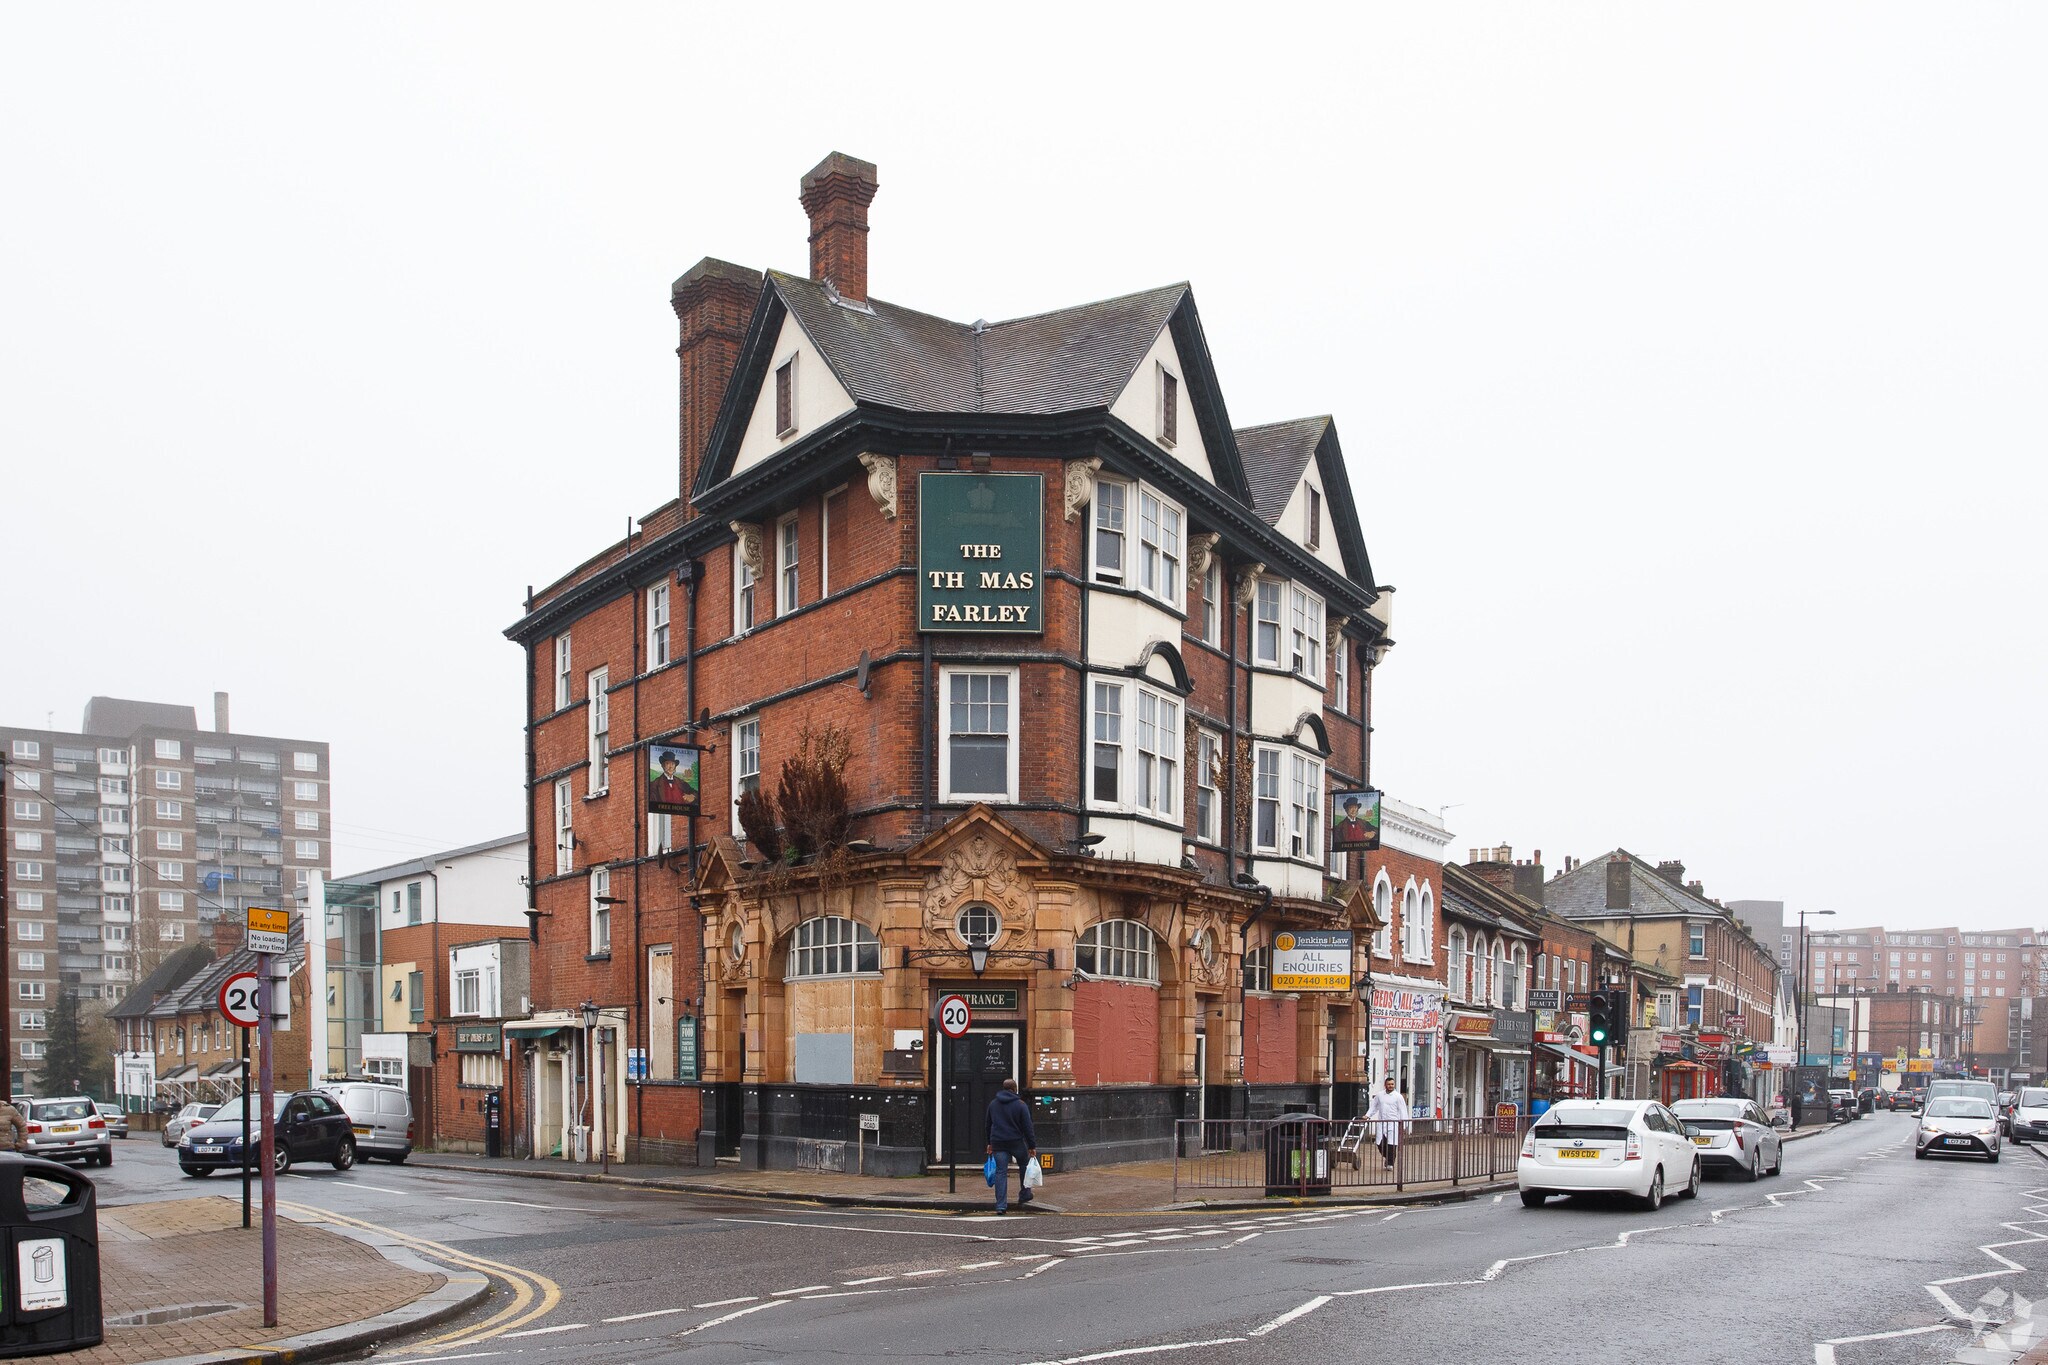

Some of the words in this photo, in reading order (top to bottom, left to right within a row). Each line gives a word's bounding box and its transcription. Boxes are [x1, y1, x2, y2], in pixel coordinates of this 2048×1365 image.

[960, 544, 1002, 558] THE
[932, 604, 1030, 622] FARLEY
[262, 935, 285, 944] loading
[1298, 936, 1328, 946] Jenkins
[1303, 952, 1324, 961] ALL
[1282, 963, 1343, 973] ENQUIRIES
[958, 994, 1005, 1005] TRANCE
[945, 1008, 966, 1025] 20
[1498, 1020, 1515, 1030] BARBER
[682, 1028, 693, 1037] FOOD
